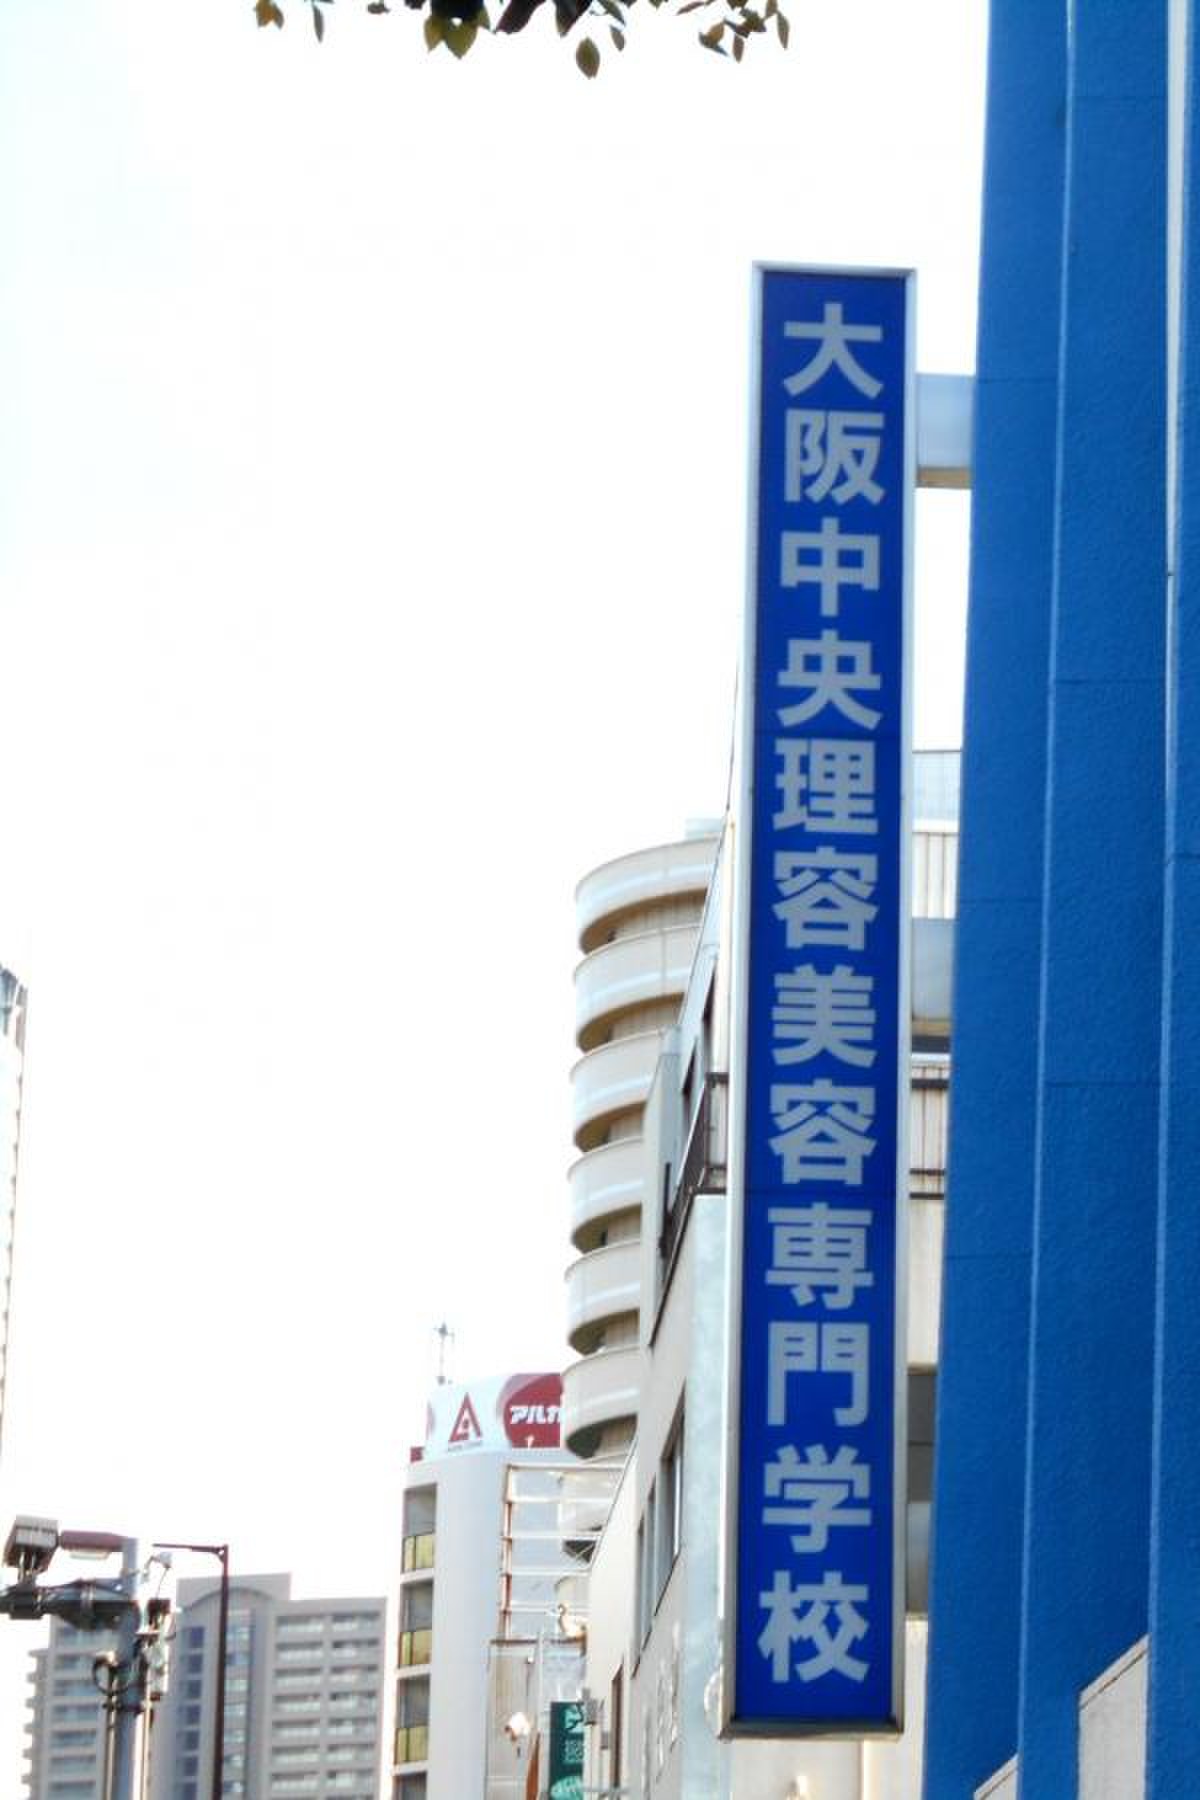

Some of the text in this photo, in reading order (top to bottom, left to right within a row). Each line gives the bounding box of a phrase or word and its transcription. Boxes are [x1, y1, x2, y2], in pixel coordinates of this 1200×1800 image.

[757, 302, 885, 1685] 大阪中央理容美容専門学校
